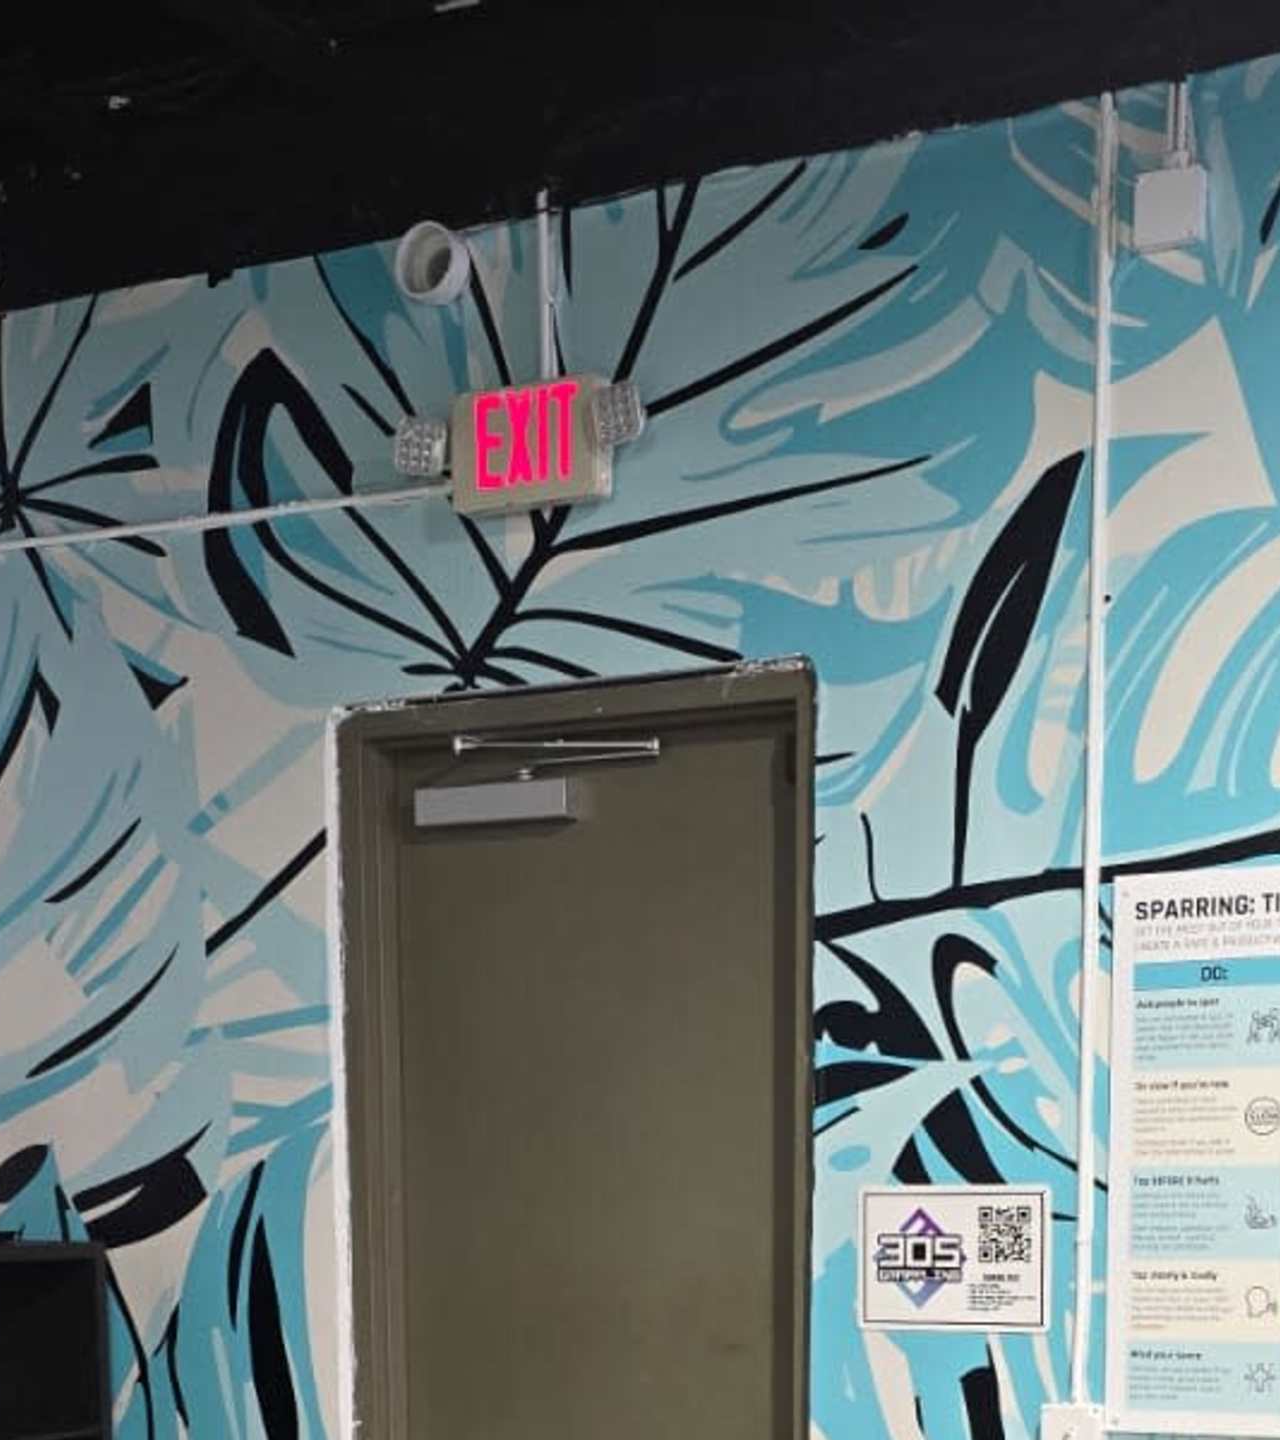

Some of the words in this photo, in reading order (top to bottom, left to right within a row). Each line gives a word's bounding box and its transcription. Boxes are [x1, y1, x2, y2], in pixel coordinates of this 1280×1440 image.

[474, 379, 580, 493] EXIT
[1135, 894, 1255, 921] SPARRING:
[1201, 966, 1228, 982] DO:
[877, 1233, 962, 1269] 305
